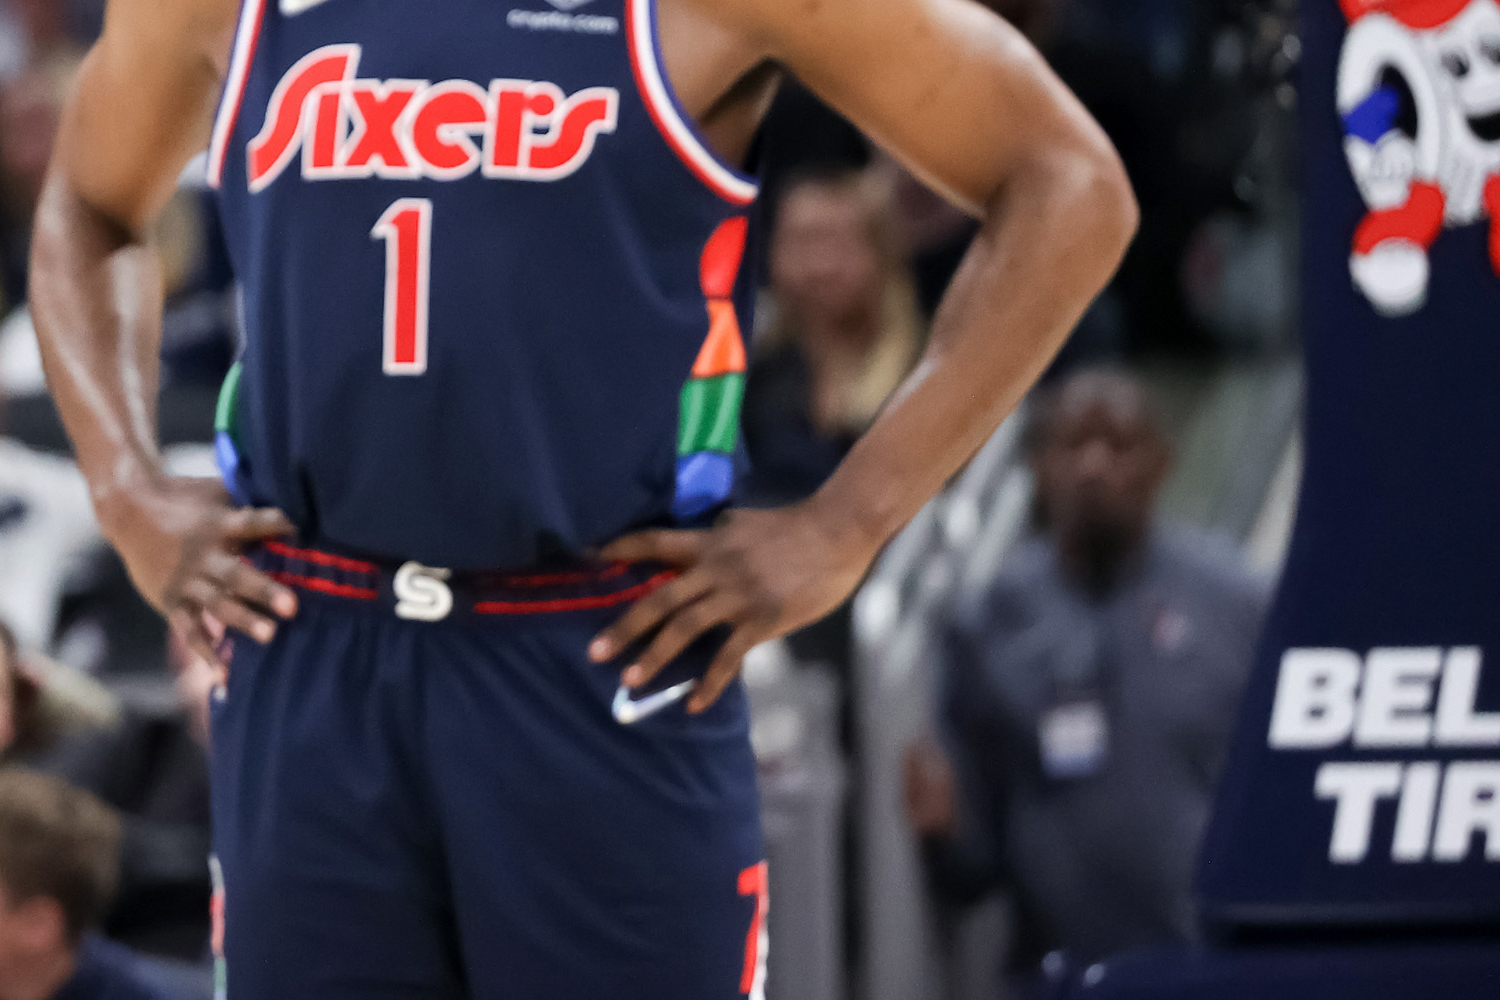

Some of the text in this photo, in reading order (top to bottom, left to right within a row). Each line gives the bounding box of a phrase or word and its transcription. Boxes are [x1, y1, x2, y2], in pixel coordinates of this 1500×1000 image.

[246, 43, 620, 193] Sixers
[370, 198, 433, 375] 1
[1267, 646, 1500, 749] BEL
